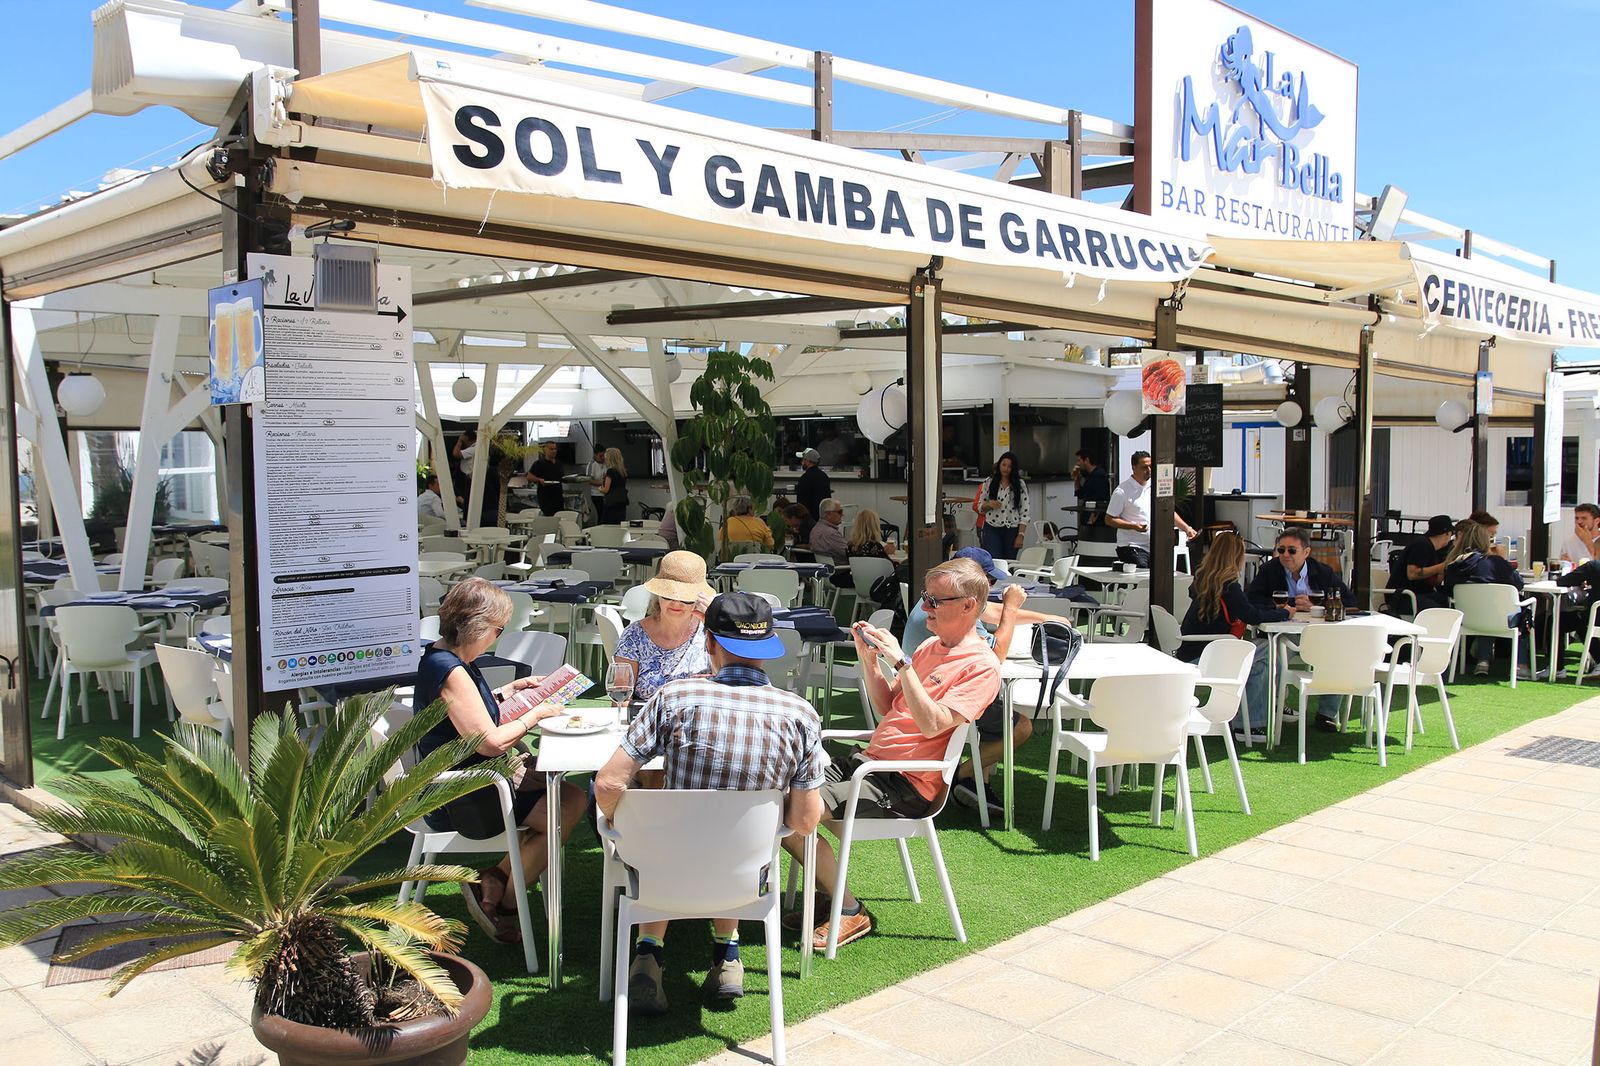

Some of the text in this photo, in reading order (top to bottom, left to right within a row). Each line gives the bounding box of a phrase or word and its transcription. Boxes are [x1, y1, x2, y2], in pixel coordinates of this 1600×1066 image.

[1265, 51, 1294, 99] La
[1181, 75, 1276, 174] Mar
[452, 105, 622, 185] SOL
[635, 138, 680, 196] Y
[704, 155, 915, 238] GAMBA
[926, 197, 986, 250] DE
[1281, 142, 1344, 204] Bella
[1161, 181, 1349, 241] BAR RESTAURANTE
[284, 274, 302, 306] La
[1423, 274, 1551, 335] CERVECERIA
[1568, 309, 1600, 339] FRE
